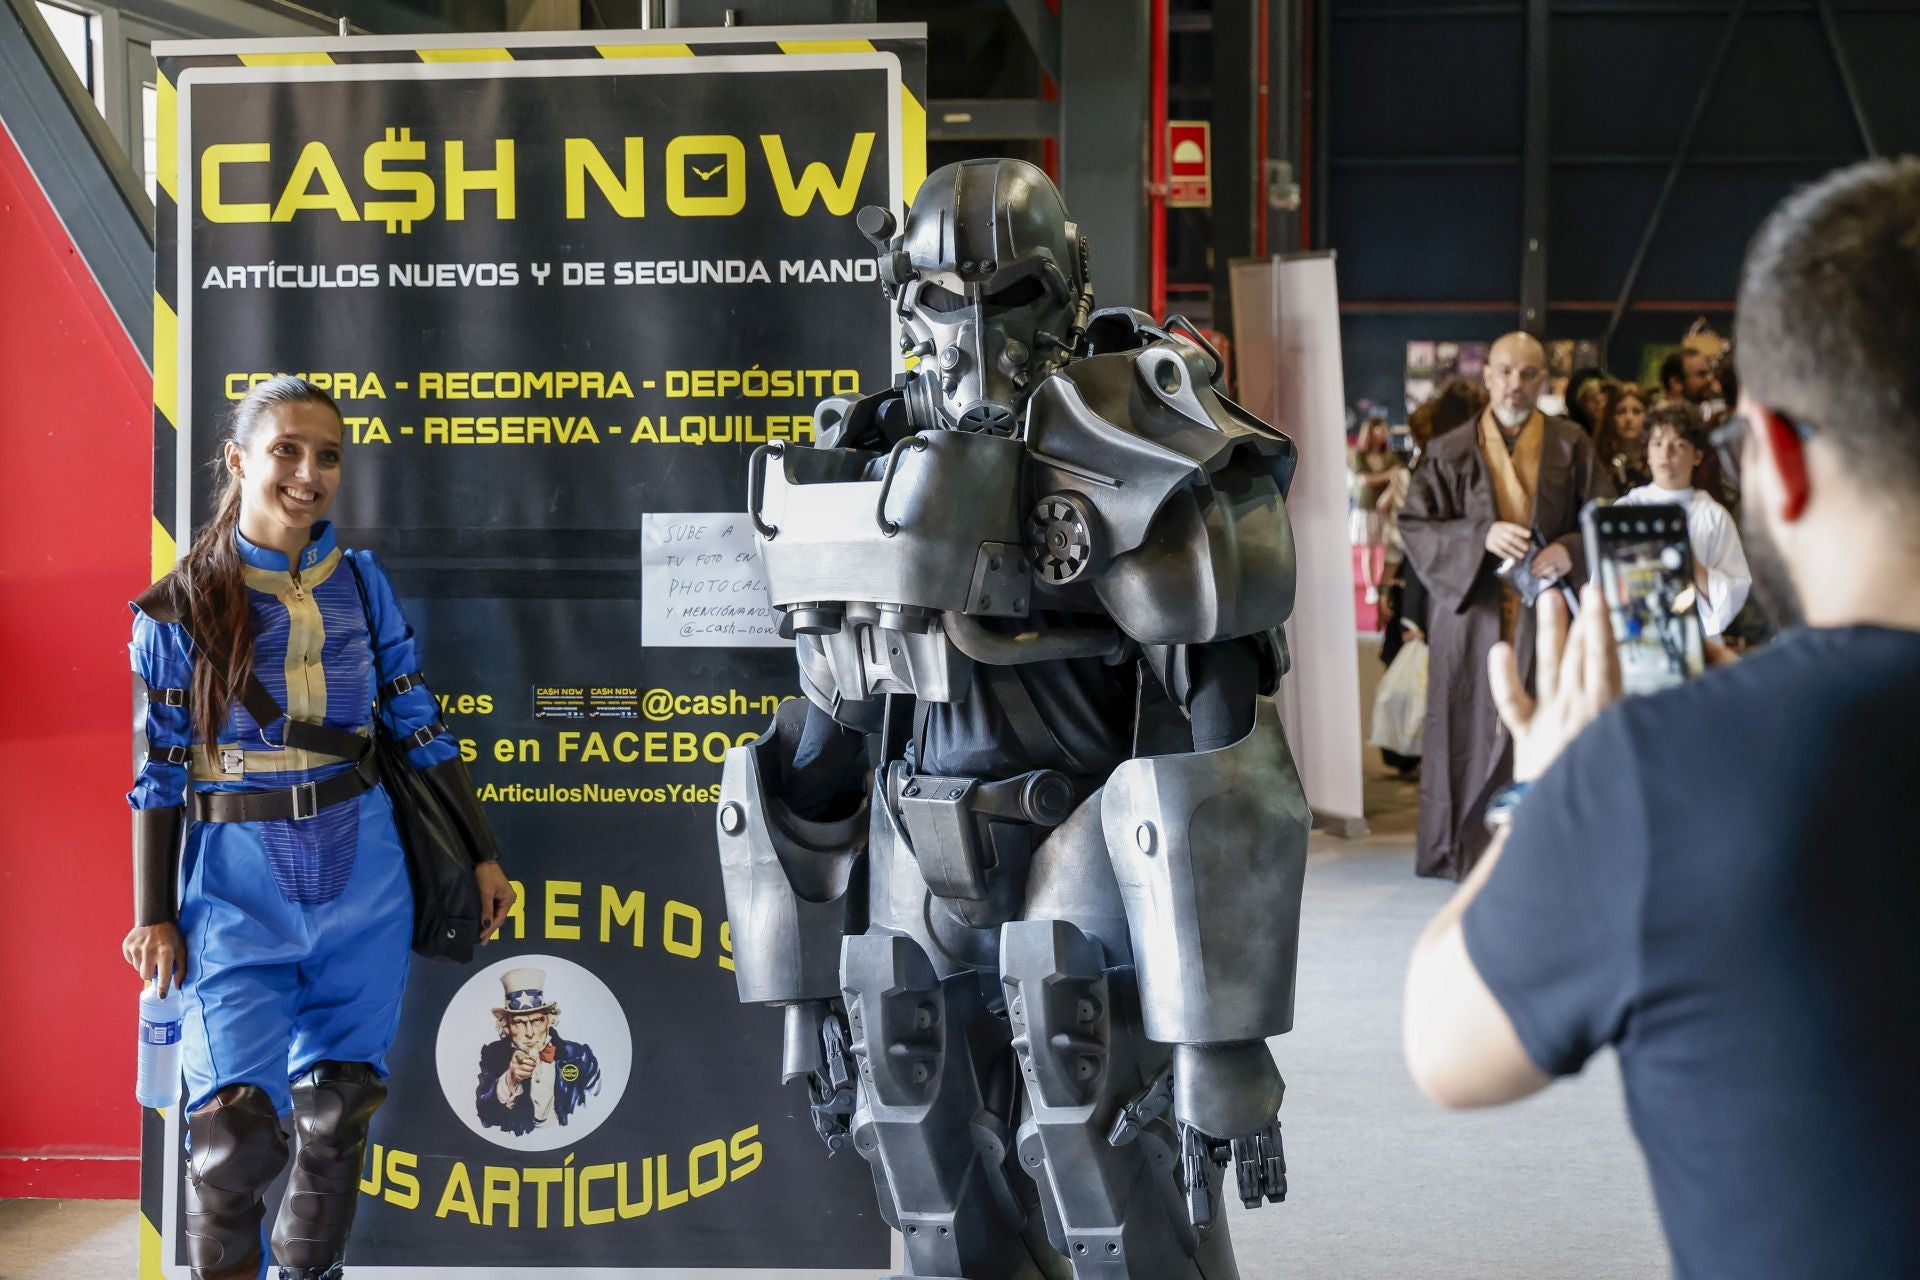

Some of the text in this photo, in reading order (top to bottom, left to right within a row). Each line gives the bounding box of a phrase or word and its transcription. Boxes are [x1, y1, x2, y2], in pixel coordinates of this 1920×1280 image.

[564, 131, 876, 220] NOW
[201, 258, 878, 290] ARTÍCULOS NUEVOS Y DE SEGUNDA MANO
[419, 370, 635, 400] RECOMPRA
[665, 364, 860, 398] DEPÓSITO
[424, 416, 600, 444] RESERVA
[630, 415, 816, 446] ALQUILER
[664, 525, 734, 543] SUBE A
[666, 555, 685, 567] TU
[695, 554, 723, 566] FOTO
[669, 578, 768, 597] PHOTOCAL
[666, 606, 674, 618] Y
[642, 688, 807, 721] @cash-n
[493, 738, 540, 763] en
[359, 1124, 764, 1230] US ARTÍCULOS
